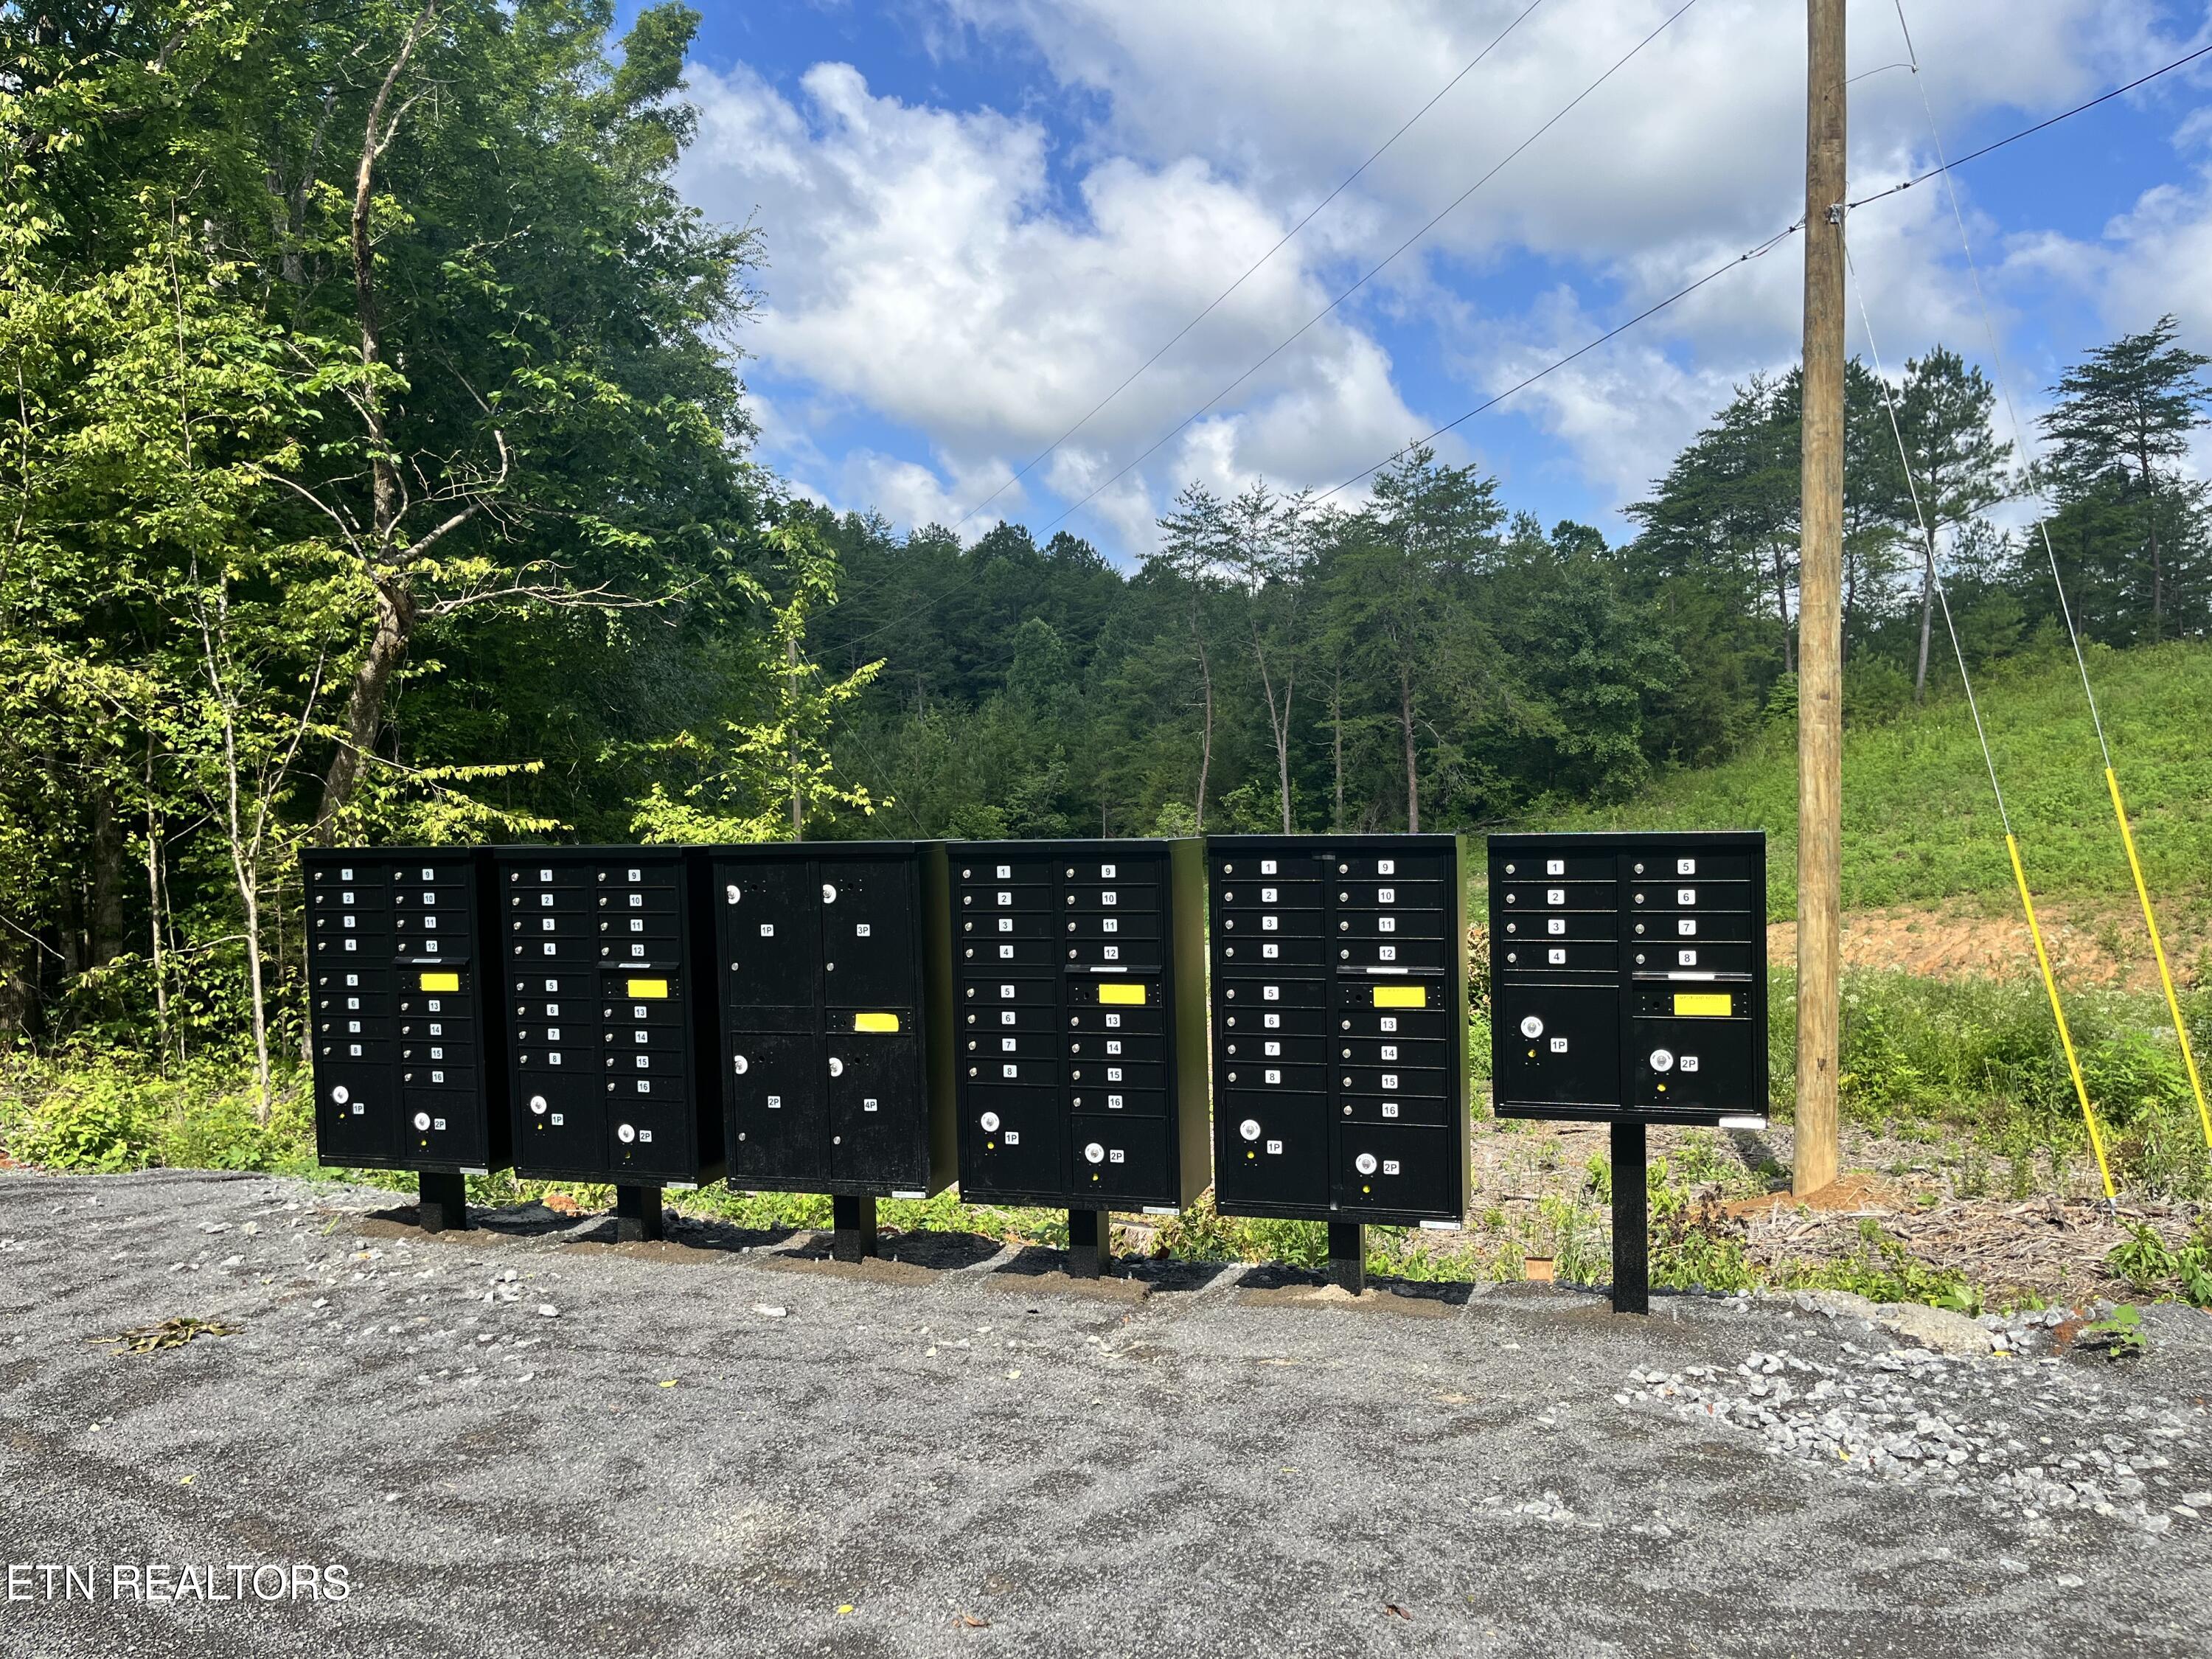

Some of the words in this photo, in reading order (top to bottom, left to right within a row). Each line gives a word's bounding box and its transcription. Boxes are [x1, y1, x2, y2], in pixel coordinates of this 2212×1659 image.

[1104, 894, 1114, 902] 10
[1380, 891, 1391, 900] 10
[631, 897, 640, 905] 10
[1105, 922, 1114, 930] 11
[1382, 920, 1391, 929] 11
[858, 926, 869, 934] 3P
[428, 942, 436, 950] 12
[1106, 949, 1116, 957] 12
[1382, 949, 1393, 958] 12
[431, 1002, 439, 1010] 13
[1107, 1017, 1118, 1025] 13
[1383, 1020, 1394, 1029] 13
[1553, 1041, 1565, 1049] 1P
[1384, 1049, 1395, 1057] 14
[638, 1058, 647, 1066] 15
[1682, 1060, 1696, 1068] 2P
[1110, 1071, 1120, 1079] 15
[1384, 1077, 1395, 1086] 15
[769, 1098, 779, 1106] 2P
[865, 1101, 876, 1109] 4P
[1110, 1098, 1121, 1107] 16
[1384, 1106, 1396, 1115] 16
[641, 1132, 650, 1140] 2P
[1006, 1134, 1018, 1142] 1P
[1269, 1143, 1280, 1151] 1P
[1111, 1152, 1122, 1161] 2P
[1385, 1164, 1397, 1172] 2P
